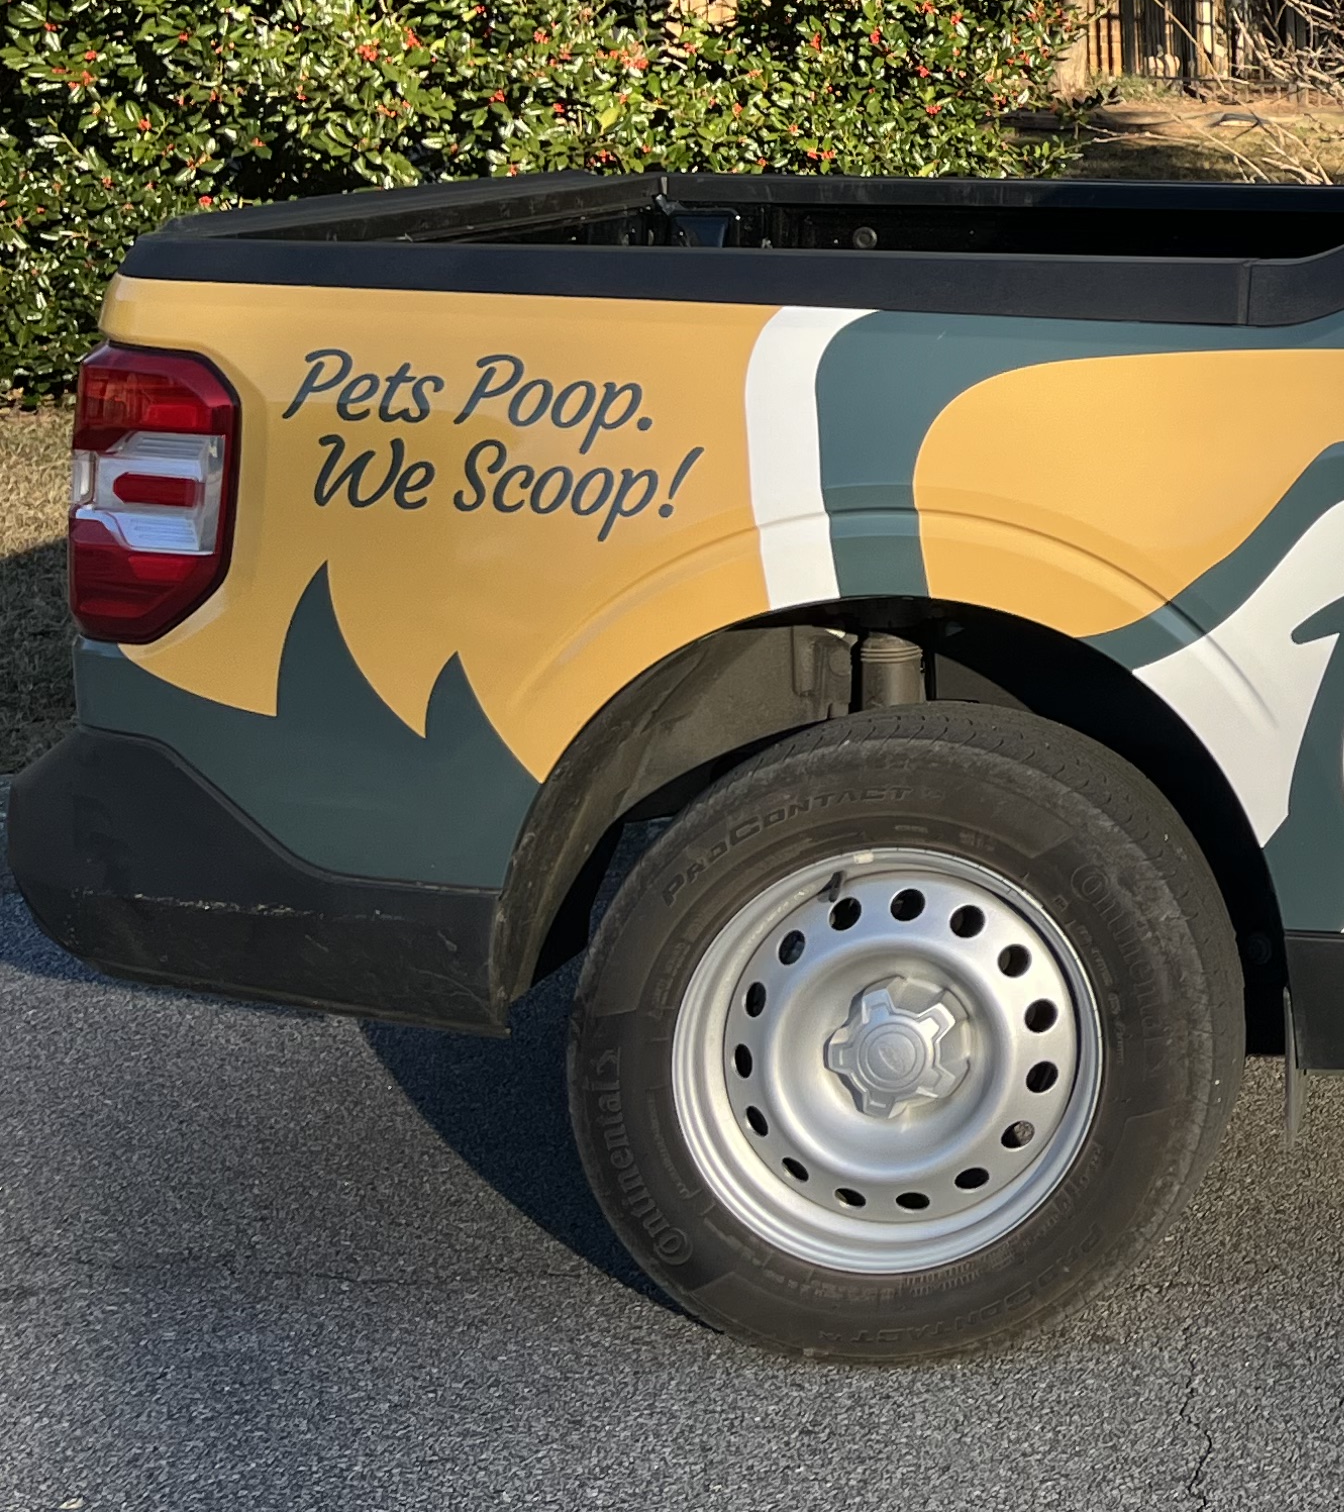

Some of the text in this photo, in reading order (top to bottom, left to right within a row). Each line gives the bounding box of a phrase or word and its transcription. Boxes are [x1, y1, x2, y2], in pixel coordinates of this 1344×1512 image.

[282, 348, 653, 455] Pets Poop.
[313, 434, 704, 543] We Scoop!
[590, 1078, 693, 1266] Continental
